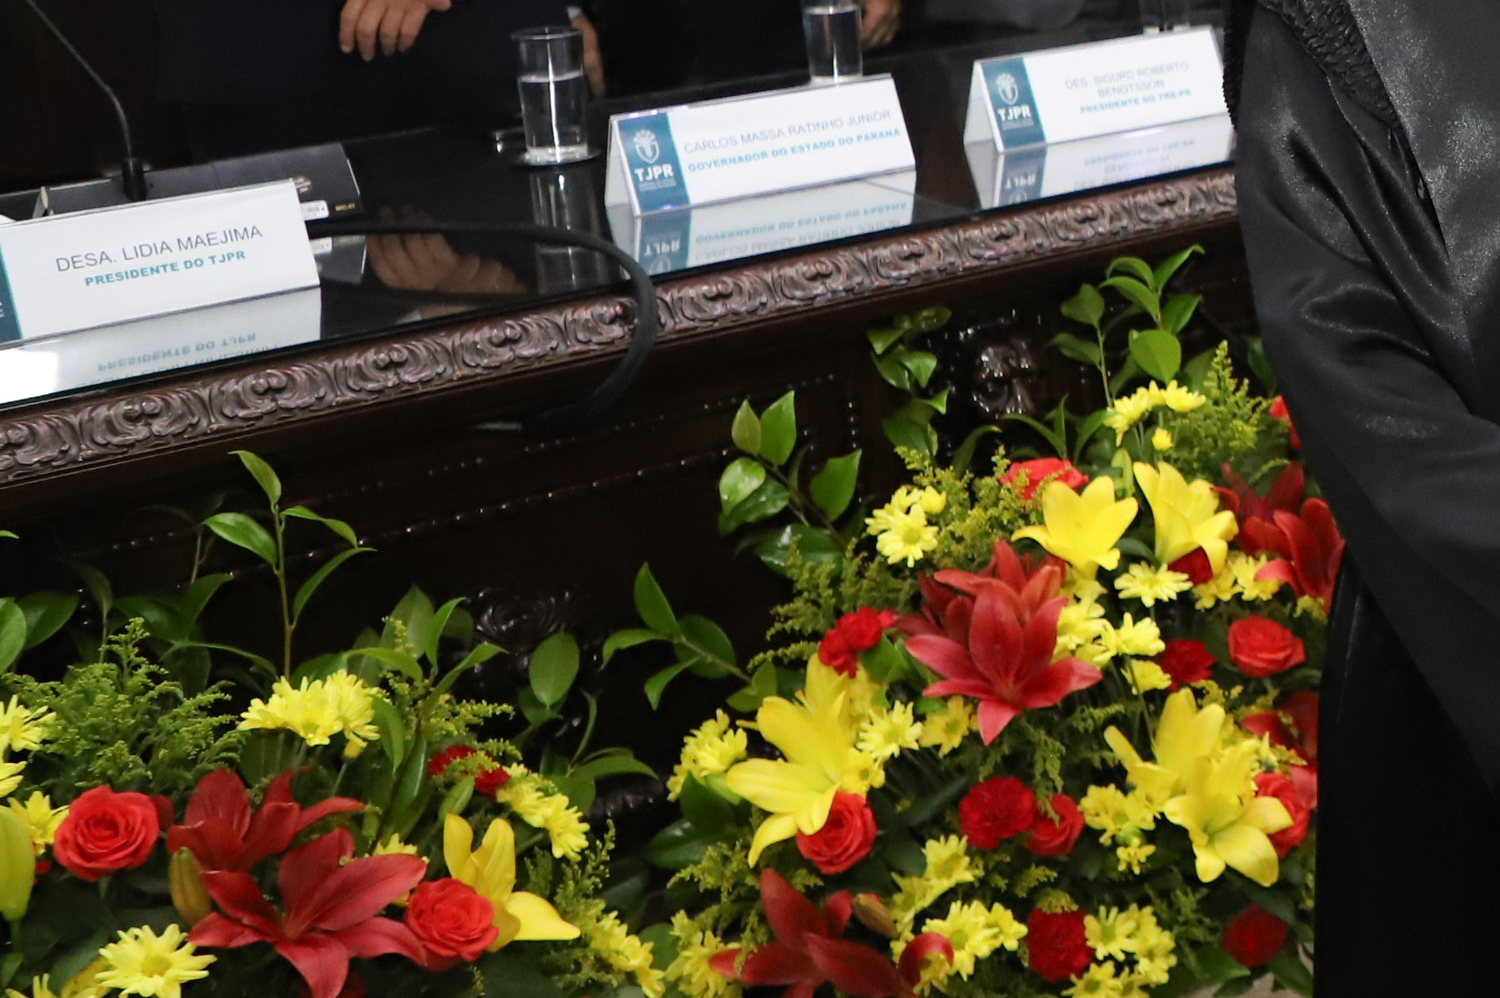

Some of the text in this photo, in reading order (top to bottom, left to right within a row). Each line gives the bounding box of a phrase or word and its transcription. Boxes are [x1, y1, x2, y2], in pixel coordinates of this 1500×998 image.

[1136, 61, 1189, 77] ROBERTO
[997, 105, 1032, 121] TJPR
[1080, 97, 1139, 113] PRESIDENTE
[1142, 94, 1156, 104] DO
[683, 135, 738, 154] CARLOS
[740, 128, 786, 145] MASSA
[788, 117, 844, 137] RATINHO
[688, 151, 768, 172] GOVERNADOR
[772, 147, 788, 158] DO
[791, 140, 836, 154] ESTADO
[839, 136, 854, 147] DO
[634, 163, 675, 182] TJPR
[56, 225, 264, 273] DESA. LIDIA MAEJIMA
[85, 250, 247, 287] PRESIDENTE DO TJPR
